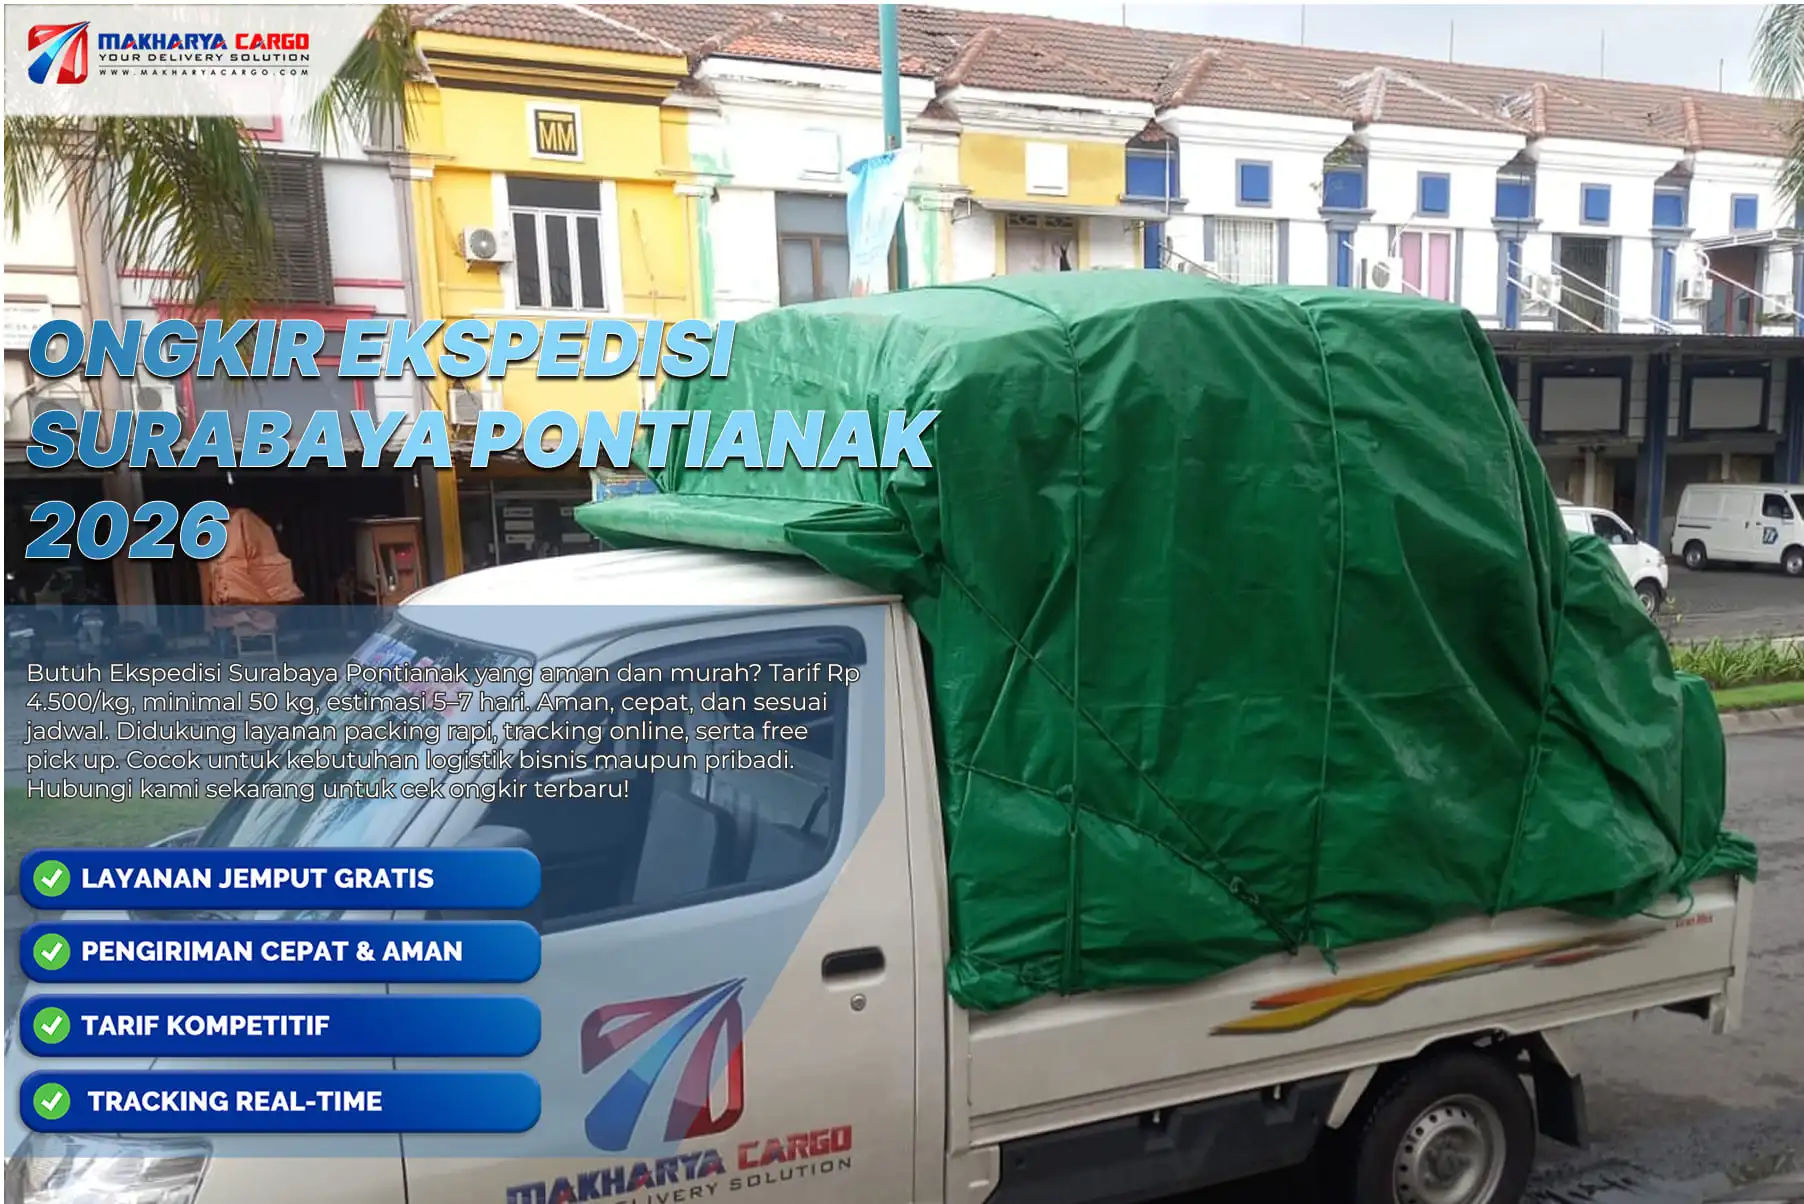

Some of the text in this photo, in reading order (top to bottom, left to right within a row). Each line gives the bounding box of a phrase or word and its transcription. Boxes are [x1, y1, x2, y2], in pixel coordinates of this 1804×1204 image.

[538, 120, 576, 153] MM
[506, 1125, 853, 1204] MAKHARYA CARGO
[729, 1158, 852, 1191] SOLUTION
